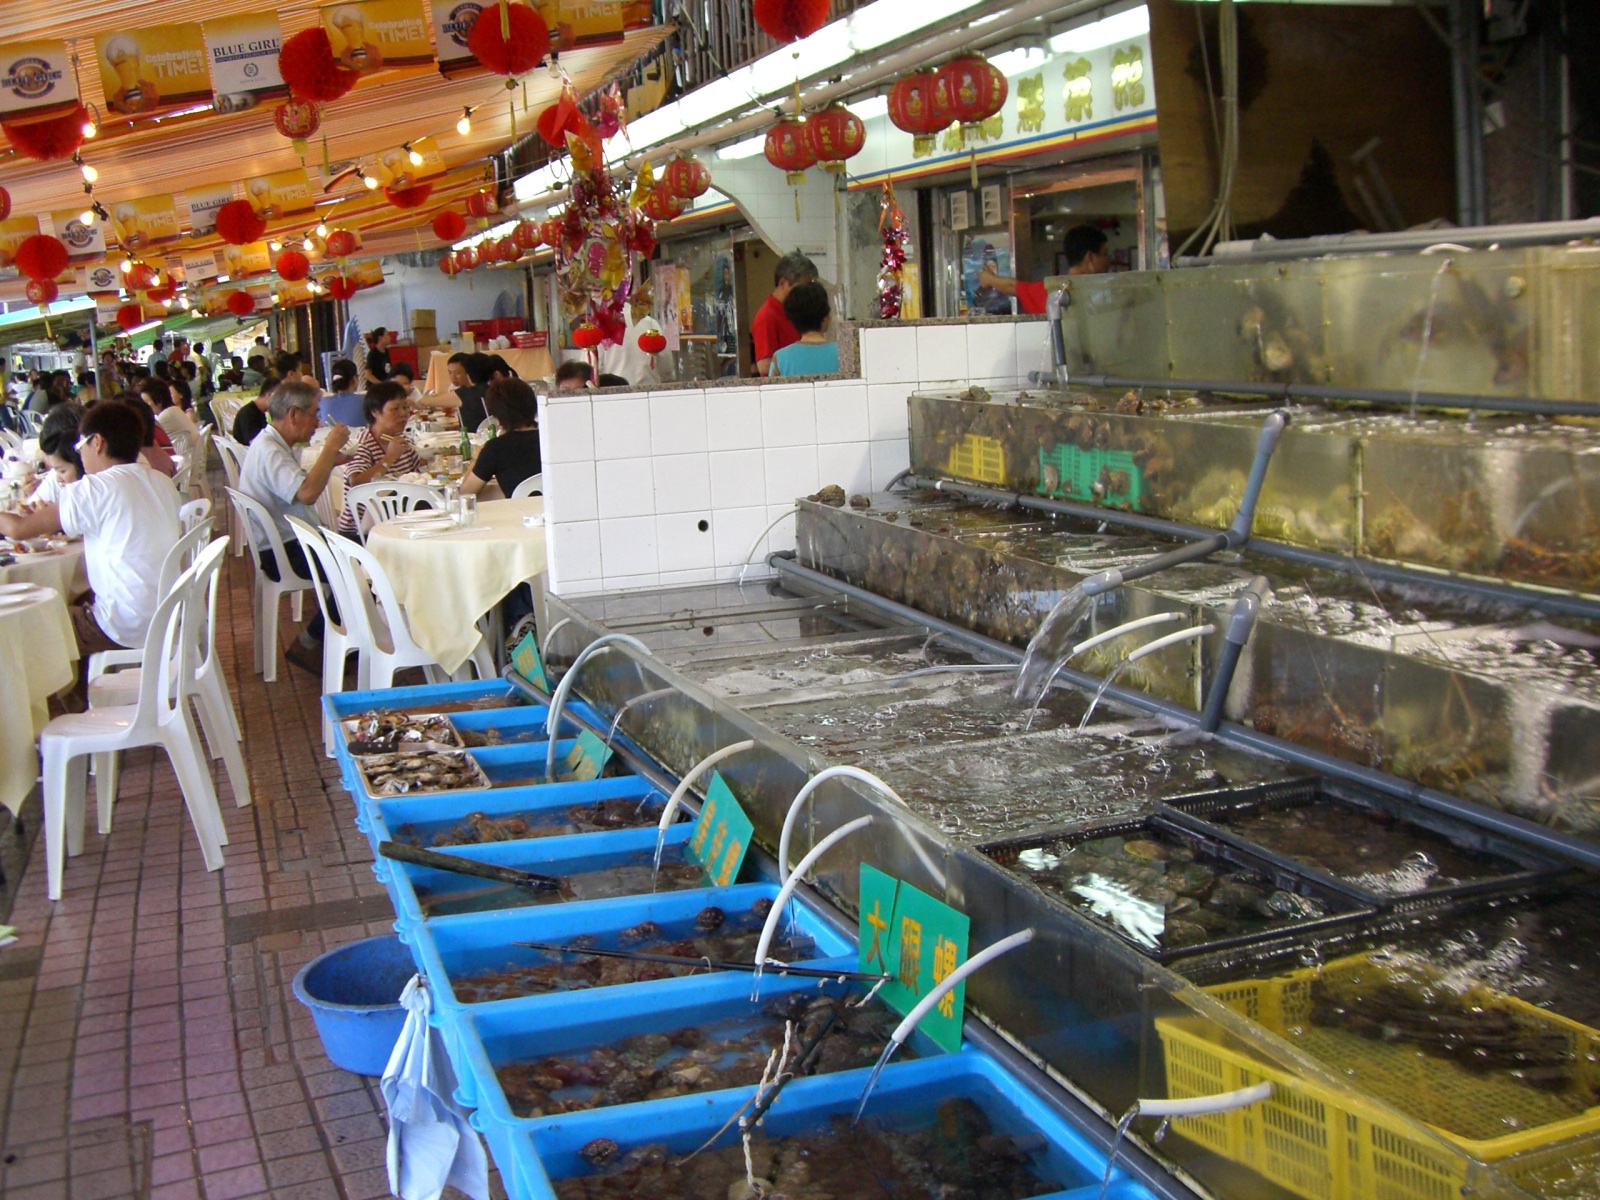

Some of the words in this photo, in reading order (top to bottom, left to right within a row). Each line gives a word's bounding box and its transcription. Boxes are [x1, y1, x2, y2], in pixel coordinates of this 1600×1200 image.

[376, 25, 425, 42] TIME!
[213, 44, 246, 57] BLUE
[248, 38, 280, 52] GIRL
[152, 57, 205, 77] TIME!
[191, 201, 209, 210] BLUE
